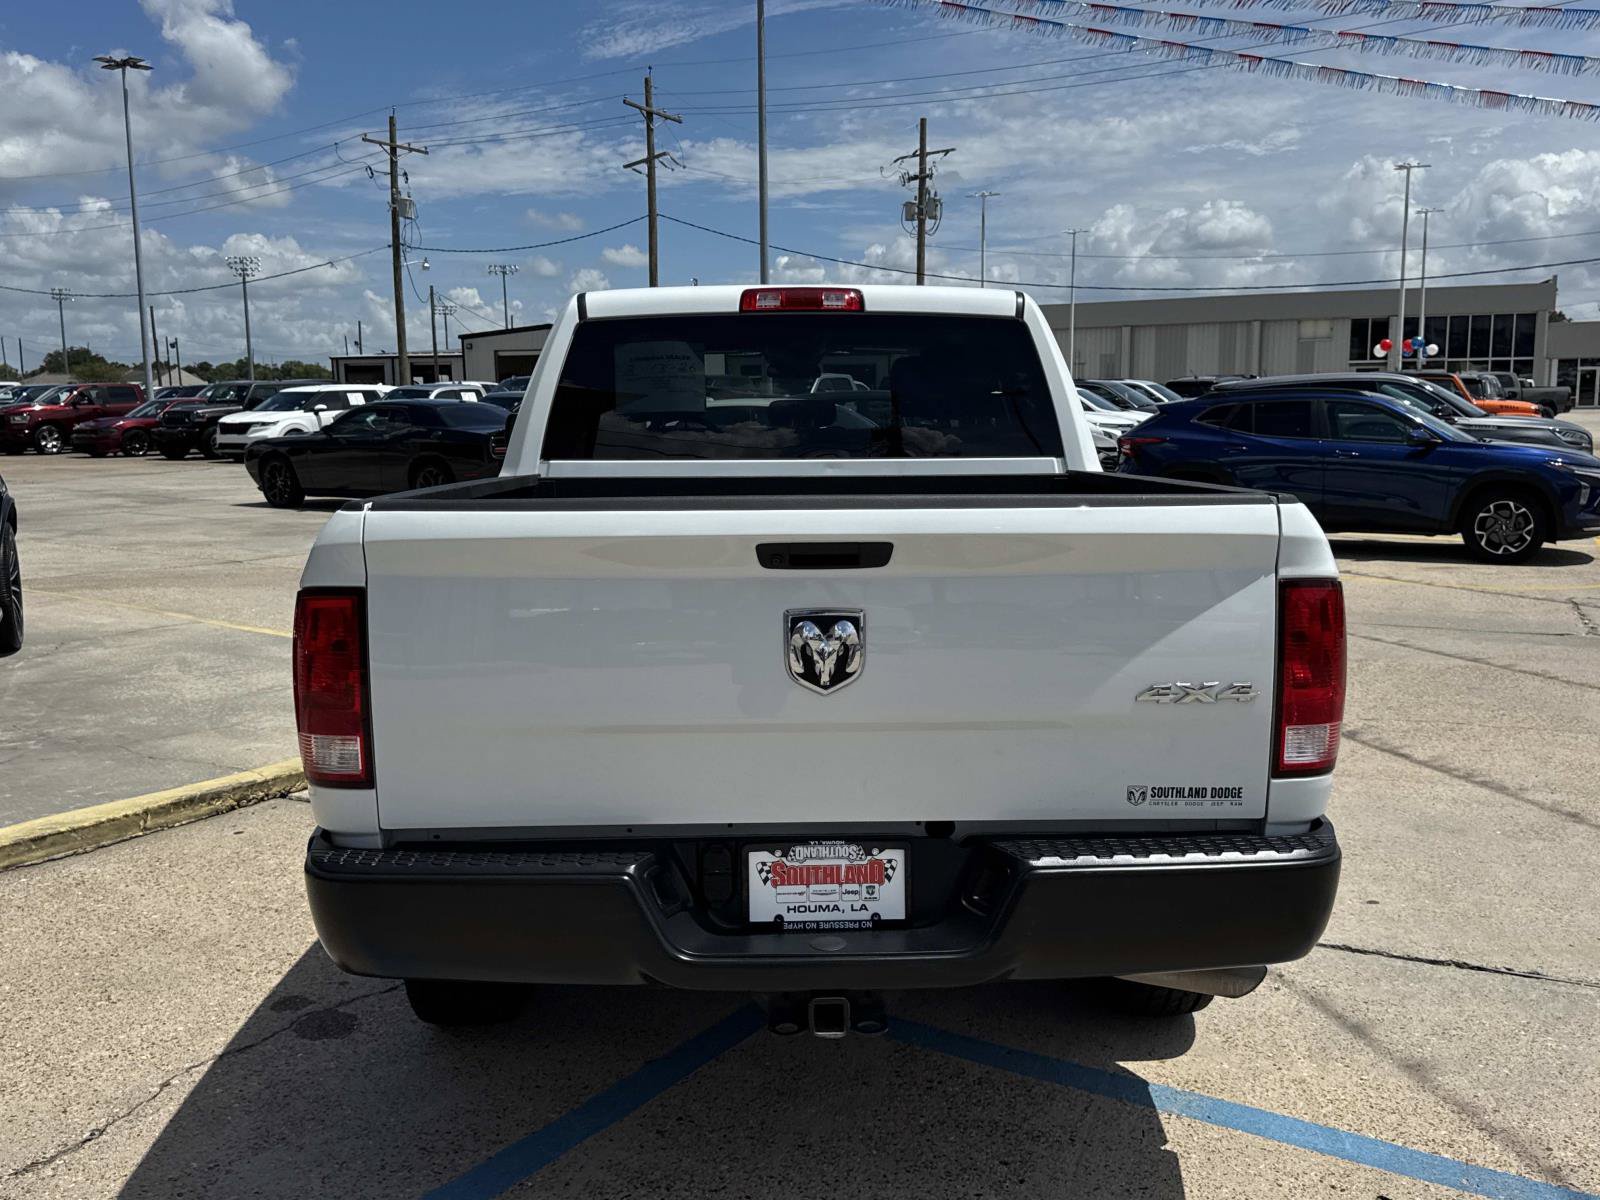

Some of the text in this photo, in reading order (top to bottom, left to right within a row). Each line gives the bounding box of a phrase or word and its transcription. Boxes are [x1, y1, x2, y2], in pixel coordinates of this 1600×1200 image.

[1135, 681, 1260, 705] 4X4
[1150, 786, 1243, 799] SOUTHLAND DODGE
[795, 845, 858, 860] SOUTHLAND
[771, 859, 885, 887] SOUTHLAND
[842, 888, 859, 896] Jeep
[786, 904, 869, 914] HOUMA, LA
[783, 921, 873, 930] NO PRESSURE NO HYPE
